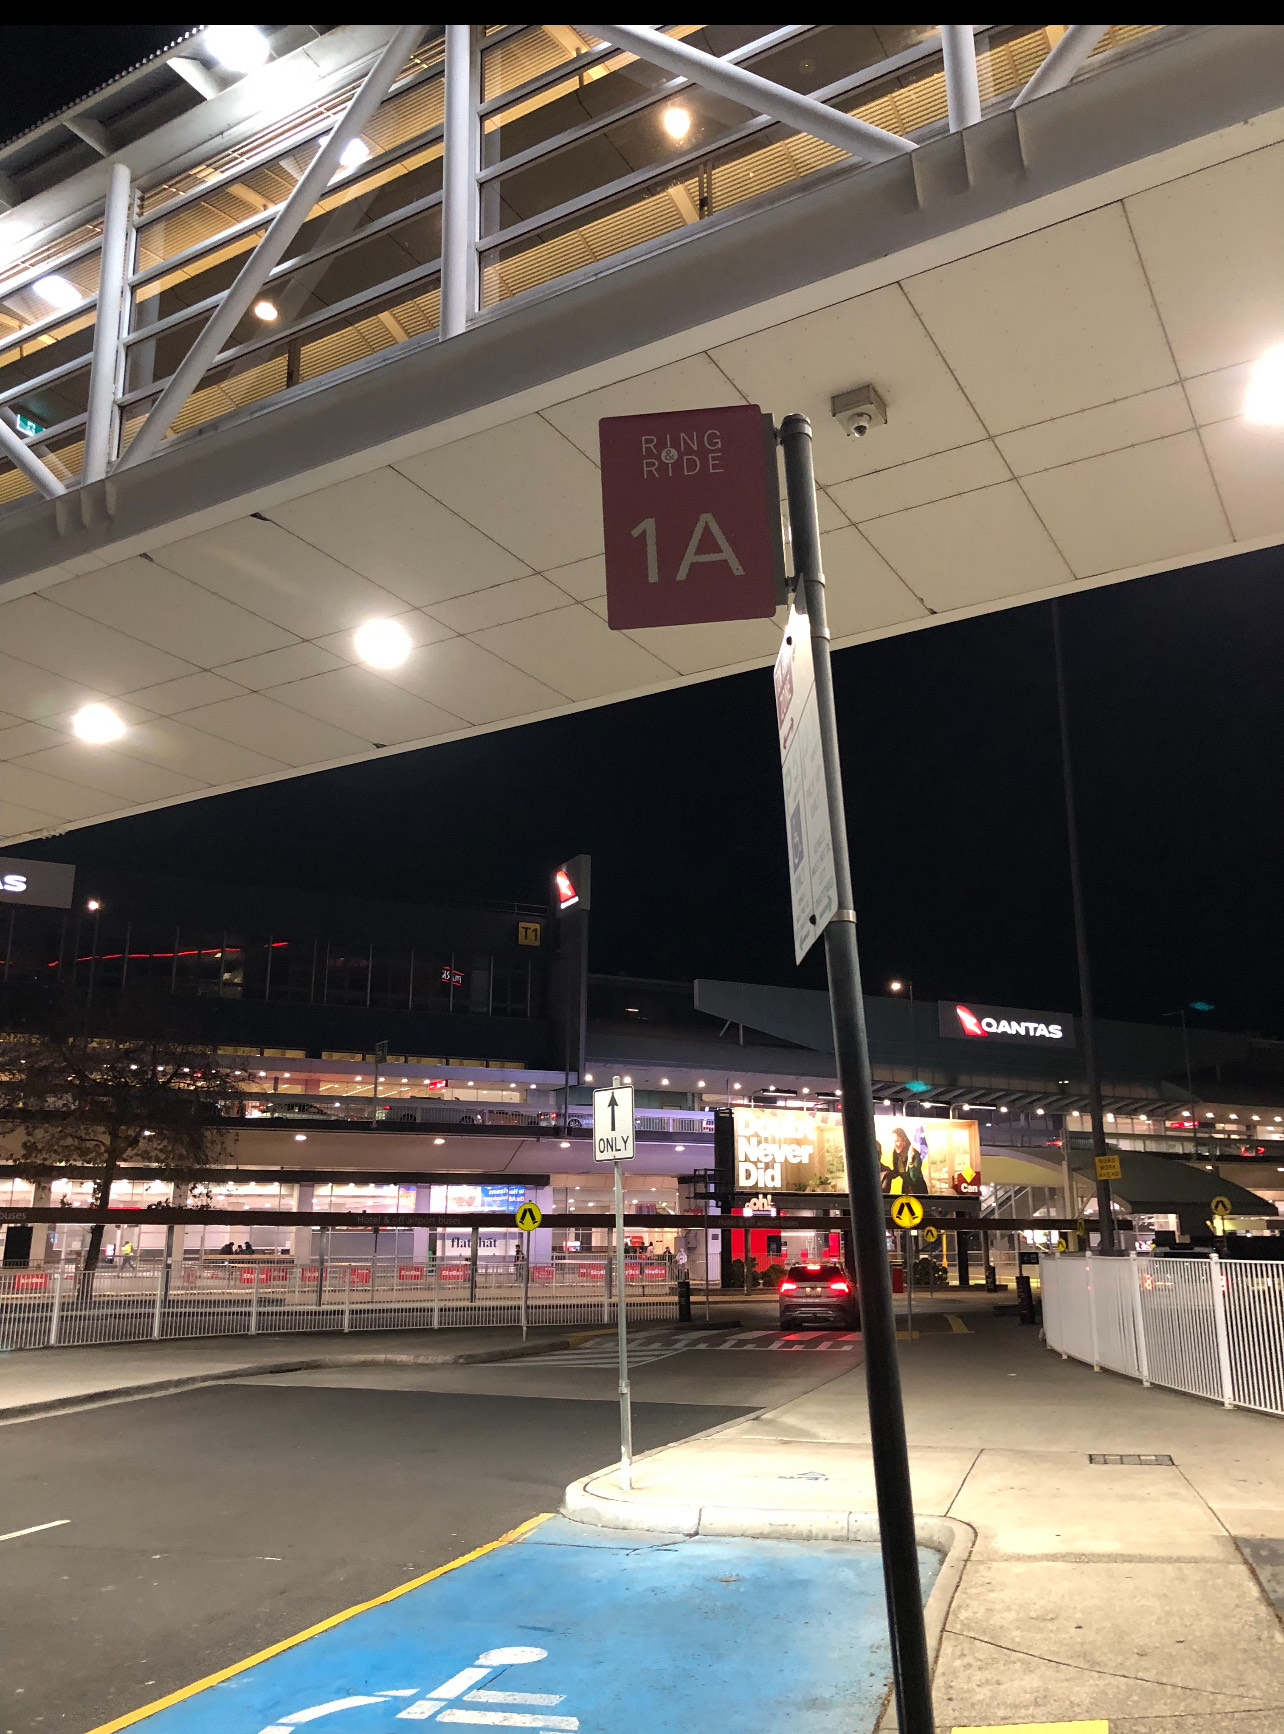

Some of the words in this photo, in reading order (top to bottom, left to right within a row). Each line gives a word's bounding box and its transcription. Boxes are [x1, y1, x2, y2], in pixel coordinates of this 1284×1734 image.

[641, 429, 722, 455] RING
[642, 453, 724, 479] RIDE
[630, 513, 745, 583] 1A
[0, 875, 27, 892] S
[521, 926, 538, 941] T1
[981, 1017, 1063, 1039] QANTAS
[598, 1133, 630, 1154] ONLY
[738, 1136, 814, 1164] Never
[738, 1161, 782, 1189] Did
[961, 1182, 979, 1193] Can
[357, 1215, 381, 1224] Hotel
[383, 1216, 390, 1224] &
[392, 1215, 405, 1224] off
[407, 1215, 436, 1226] airport
[438, 1216, 462, 1225] buses
[451, 1236, 471, 1248] flat
